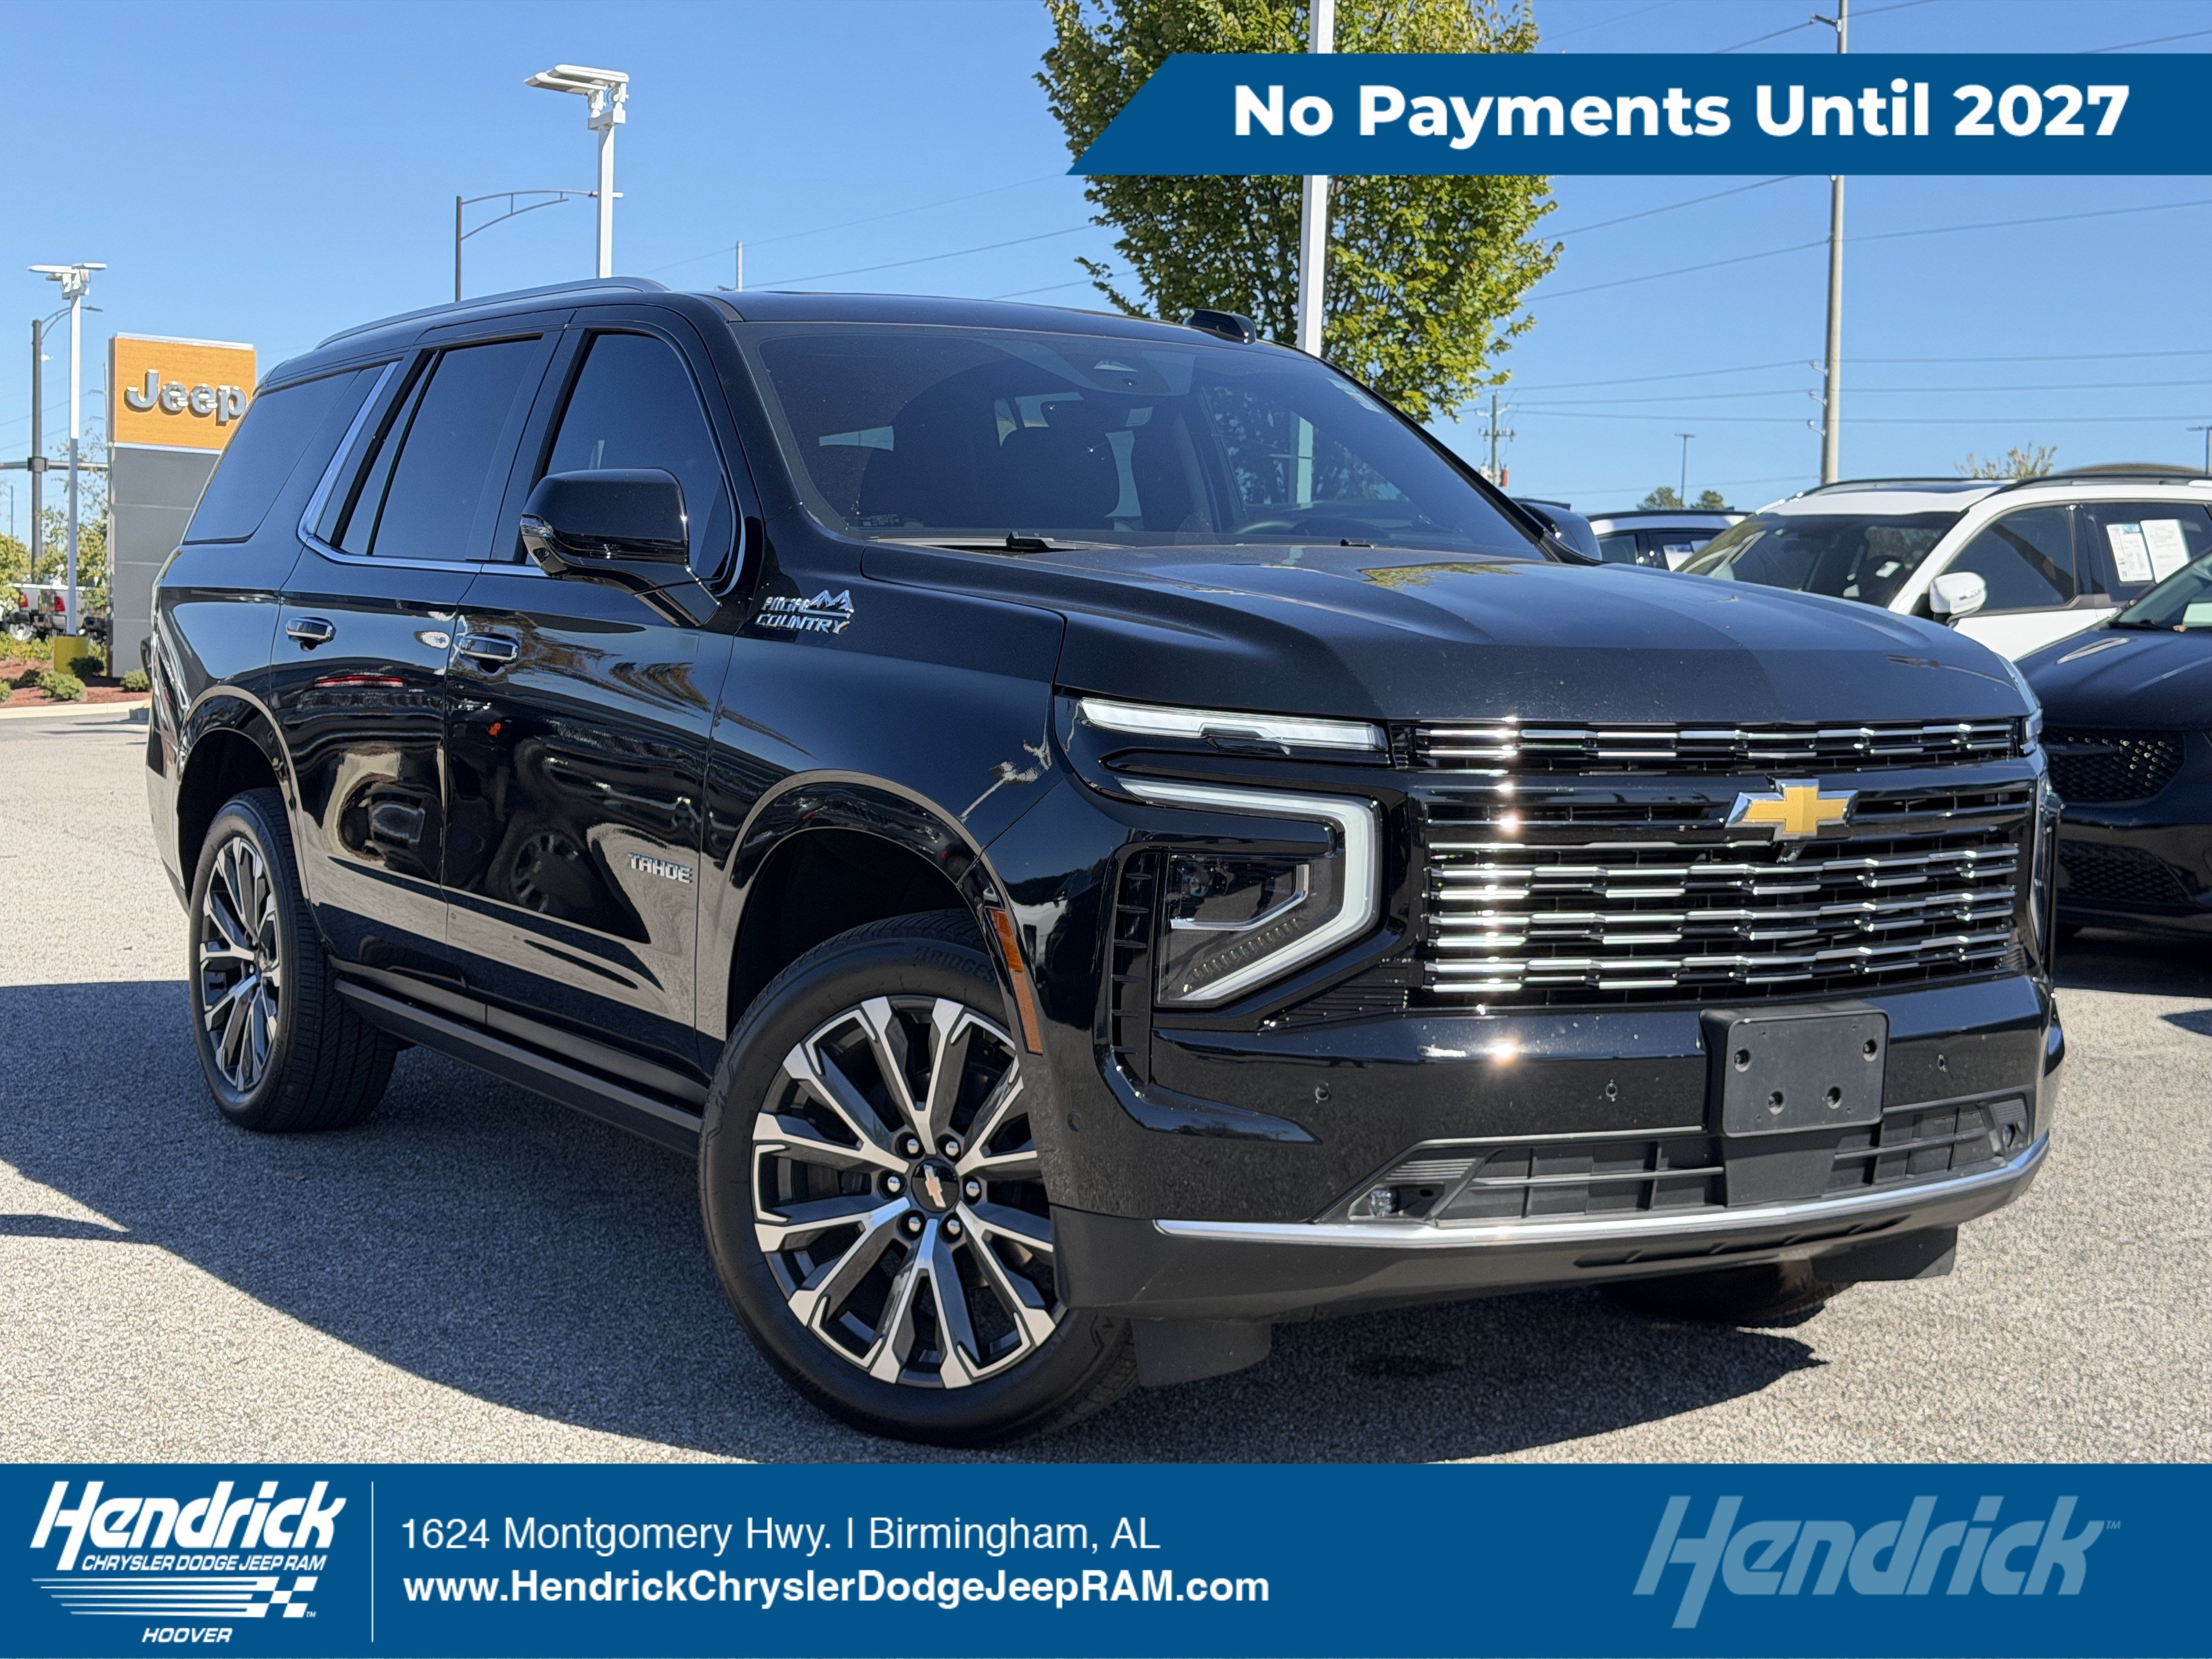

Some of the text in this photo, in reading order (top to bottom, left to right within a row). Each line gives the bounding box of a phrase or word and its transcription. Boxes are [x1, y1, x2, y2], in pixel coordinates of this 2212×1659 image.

[125, 369, 247, 426] Jeep
[755, 613, 850, 635] COUNTRY
[628, 852, 693, 884] TAHOE
